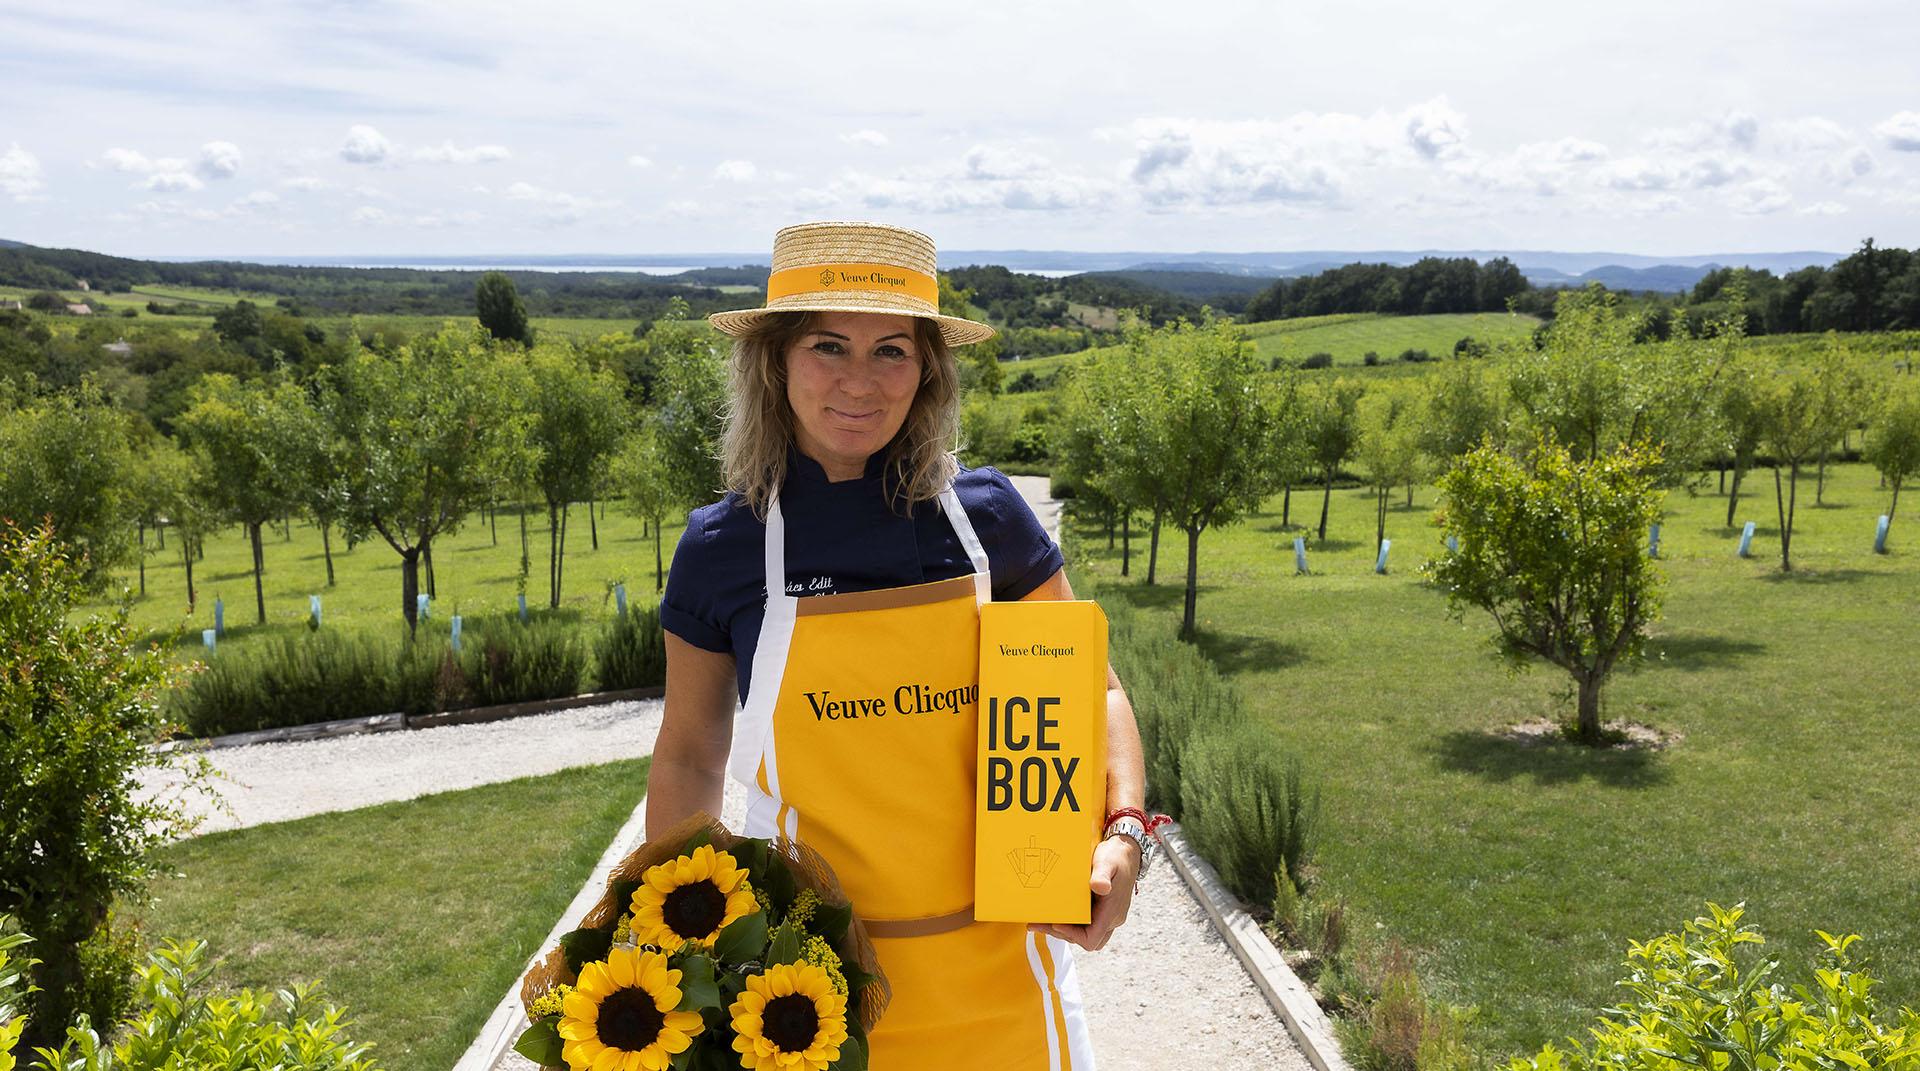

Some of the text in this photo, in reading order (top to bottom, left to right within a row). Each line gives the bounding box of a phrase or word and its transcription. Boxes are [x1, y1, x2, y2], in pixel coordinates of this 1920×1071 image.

[841, 272, 906, 287] Veuve Clicquot
[808, 576, 834, 591] Edit
[999, 643, 1075, 658] Veuve Clicquot
[803, 684, 979, 721] Veuve Clicquo
[988, 696, 1061, 751] ICE
[987, 756, 1081, 812] BOX
